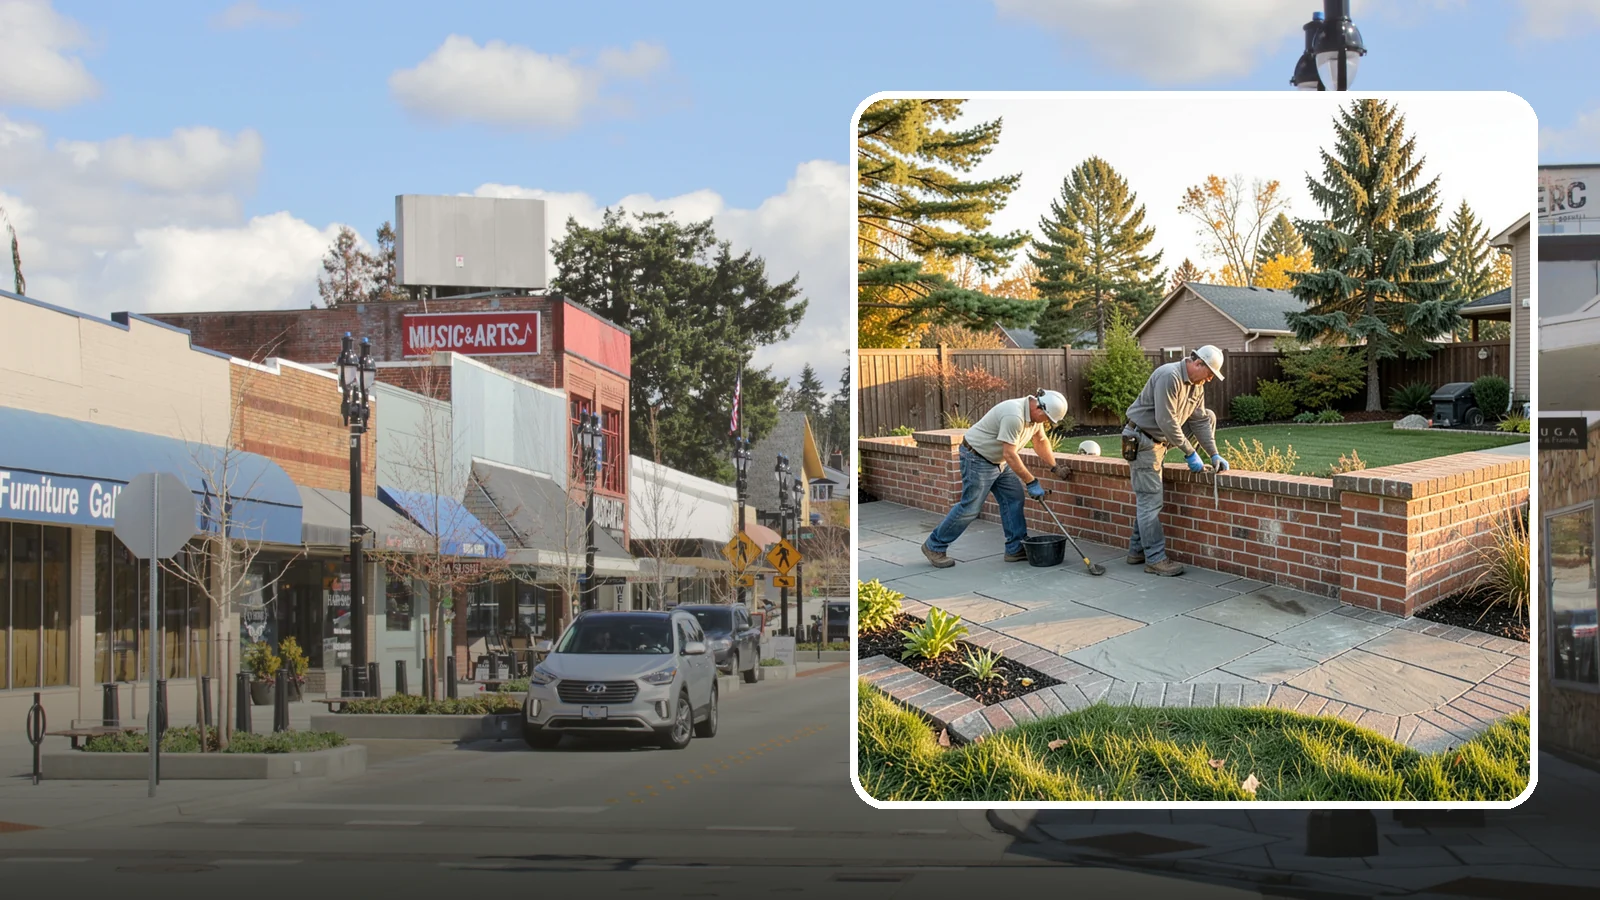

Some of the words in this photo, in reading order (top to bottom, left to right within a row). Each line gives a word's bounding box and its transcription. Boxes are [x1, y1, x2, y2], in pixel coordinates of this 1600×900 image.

[0, 471, 79, 515] Furniture
[89, 482, 122, 519] Gal
[454, 563, 479, 575] SUSHI
